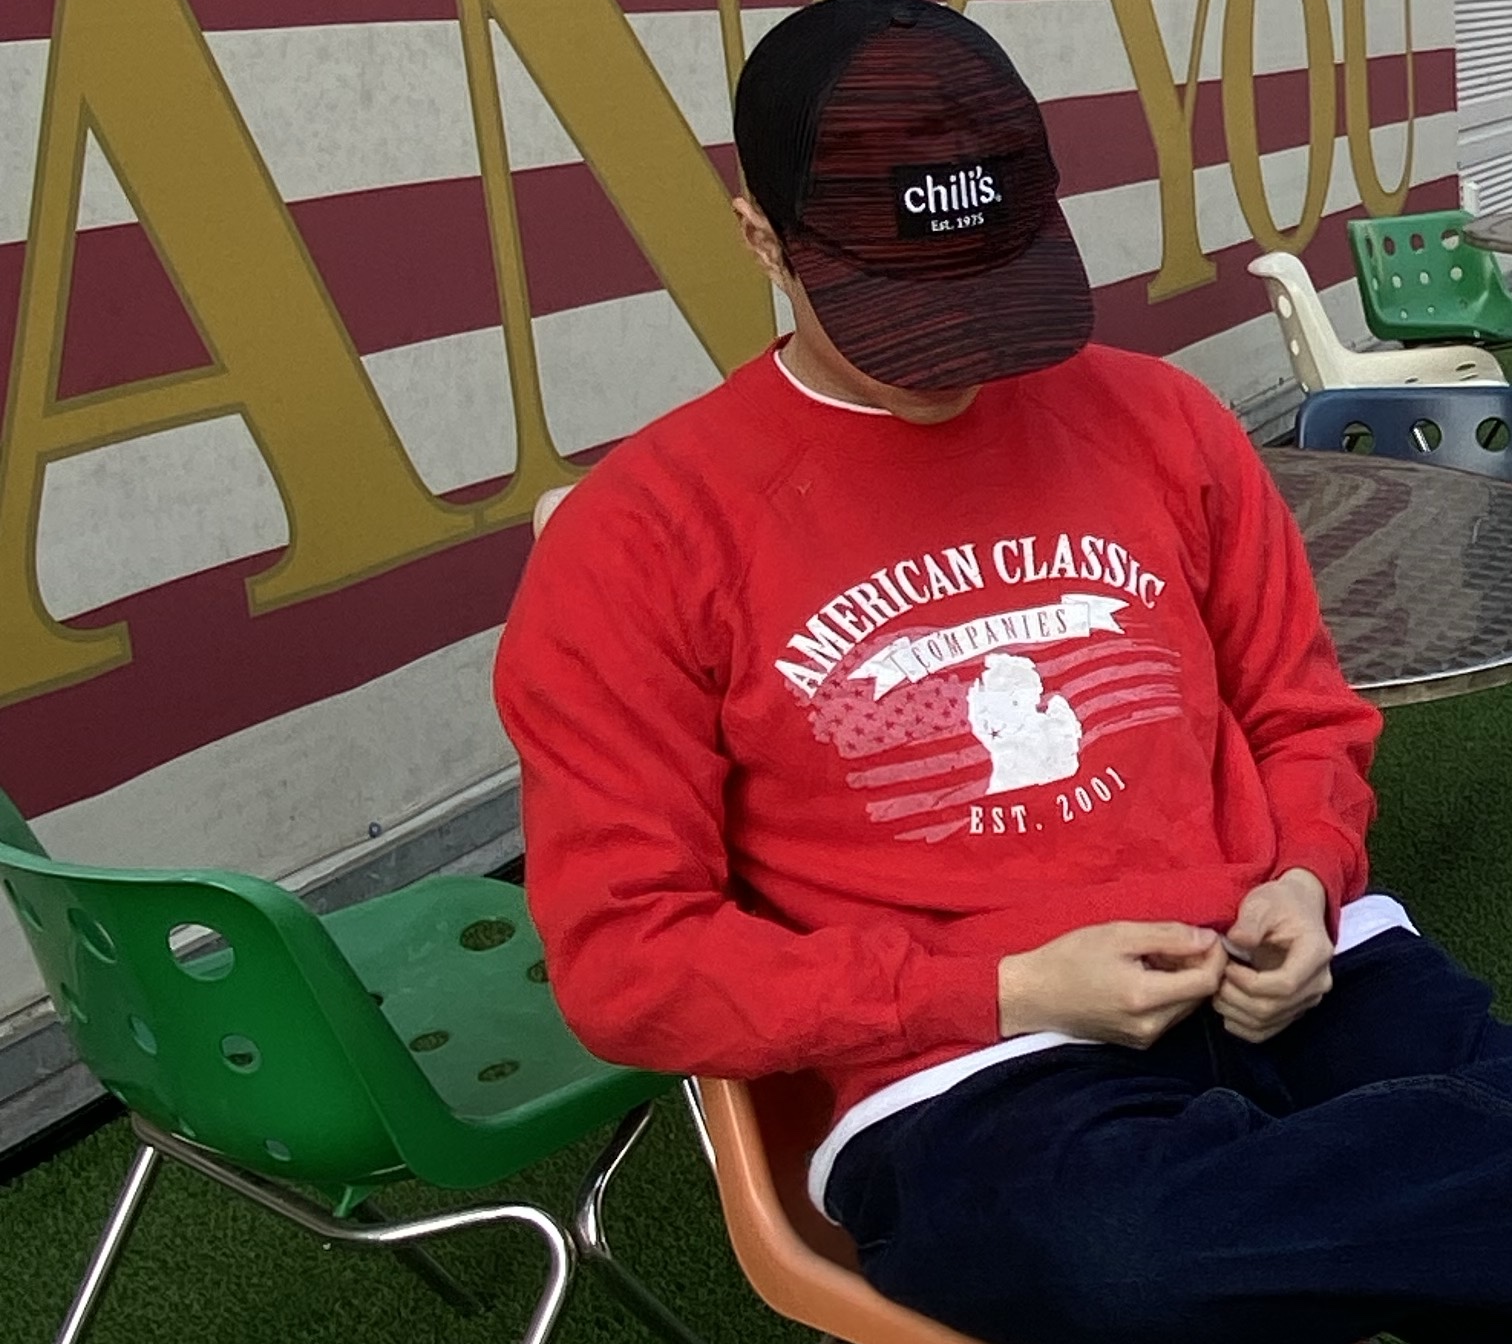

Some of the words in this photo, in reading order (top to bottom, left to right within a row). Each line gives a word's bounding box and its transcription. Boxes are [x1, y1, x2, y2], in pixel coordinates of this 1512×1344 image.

[903, 164, 996, 214] chili's
[930, 218, 955, 232] Est.
[956, 211, 985, 229] 1975
[774, 543, 986, 699] AMERICAN
[992, 533, 1166, 609] CLASSIC
[914, 608, 1068, 671] COMPANIES
[970, 804, 1044, 834] EST.
[1056, 767, 1128, 823] 2001
